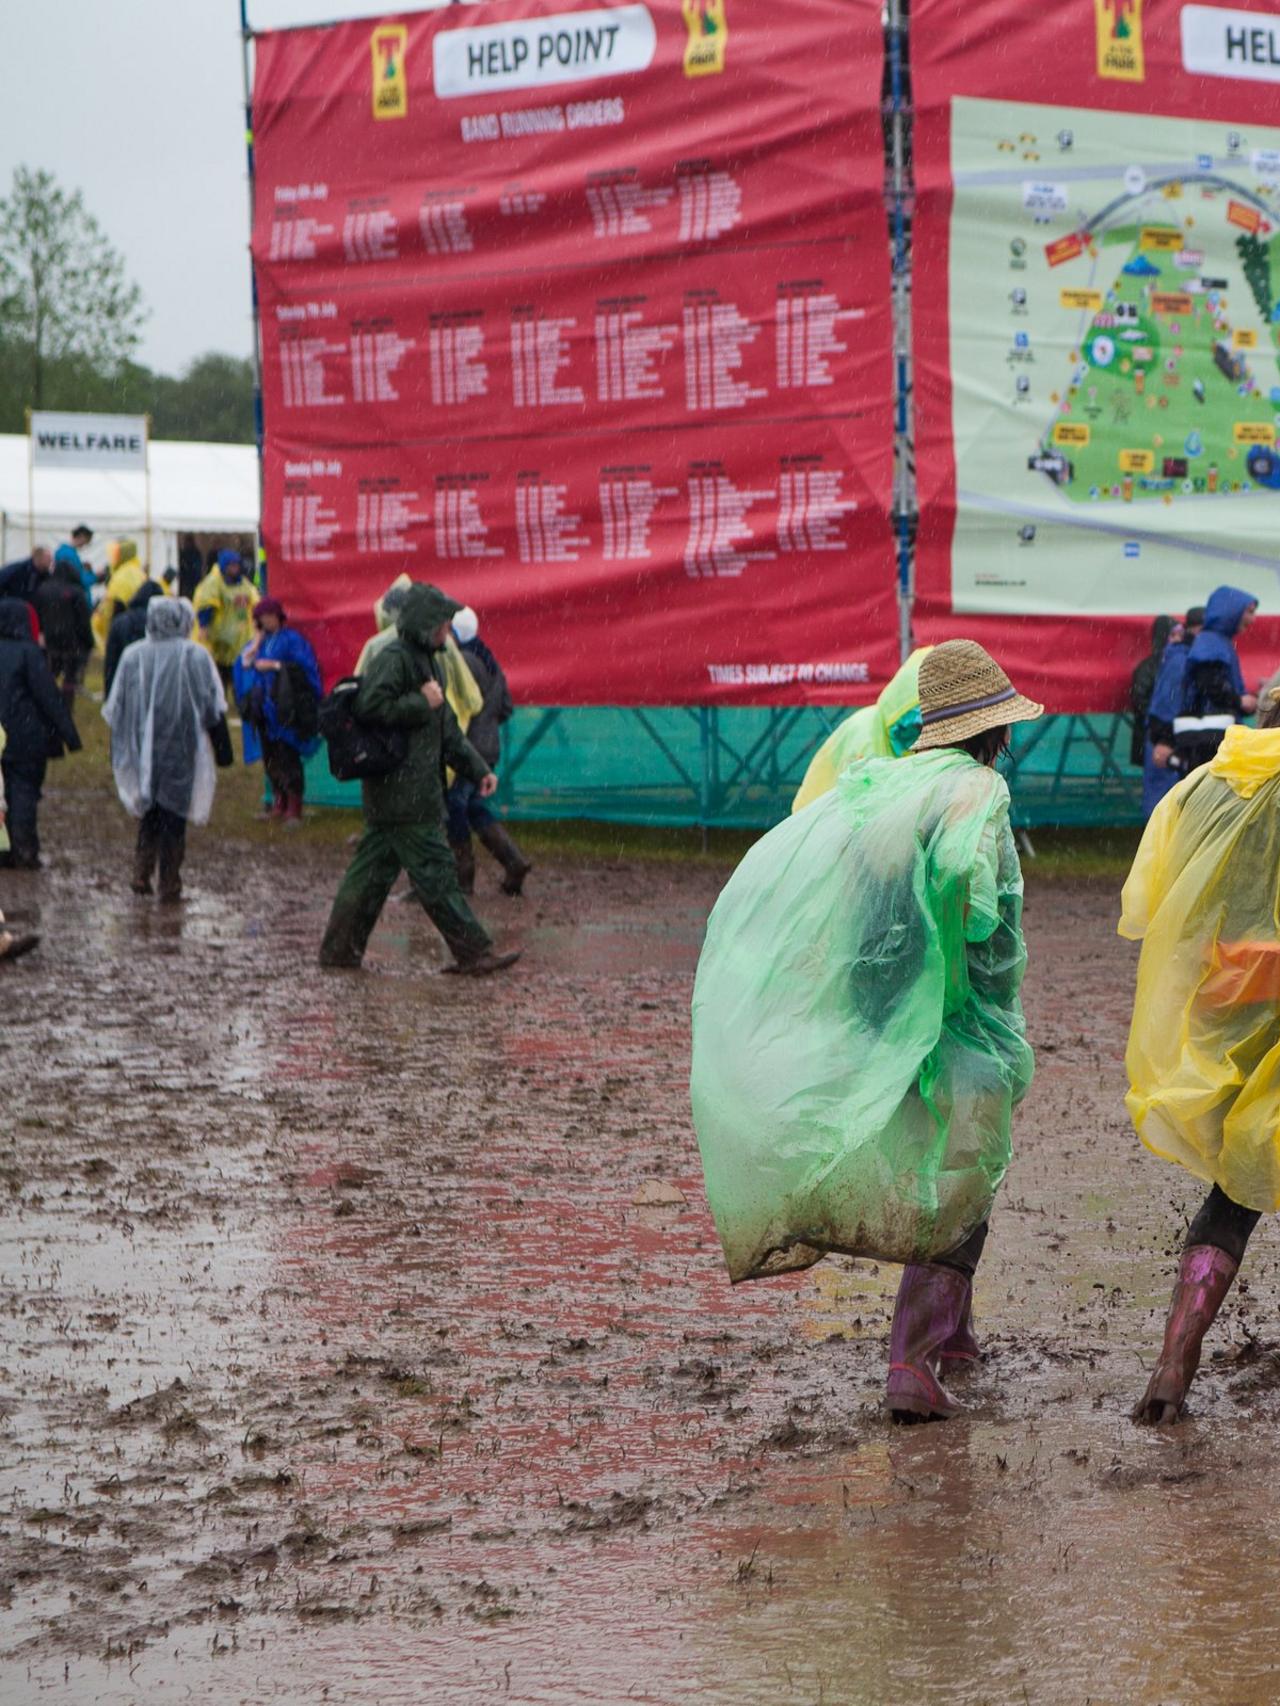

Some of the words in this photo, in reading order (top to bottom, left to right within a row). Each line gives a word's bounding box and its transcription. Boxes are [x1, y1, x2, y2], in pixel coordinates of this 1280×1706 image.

[468, 38, 528, 77] HELP
[538, 26, 620, 69] POINT
[461, 113, 500, 143] BAND
[501, 105, 565, 138] RUNNING
[566, 97, 625, 130] ORDERS
[37, 431, 142, 453] WELFARE
[707, 664, 744, 684] TIMES
[745, 663, 796, 684] SUBJECT
[815, 662, 869, 683] CHANGE
